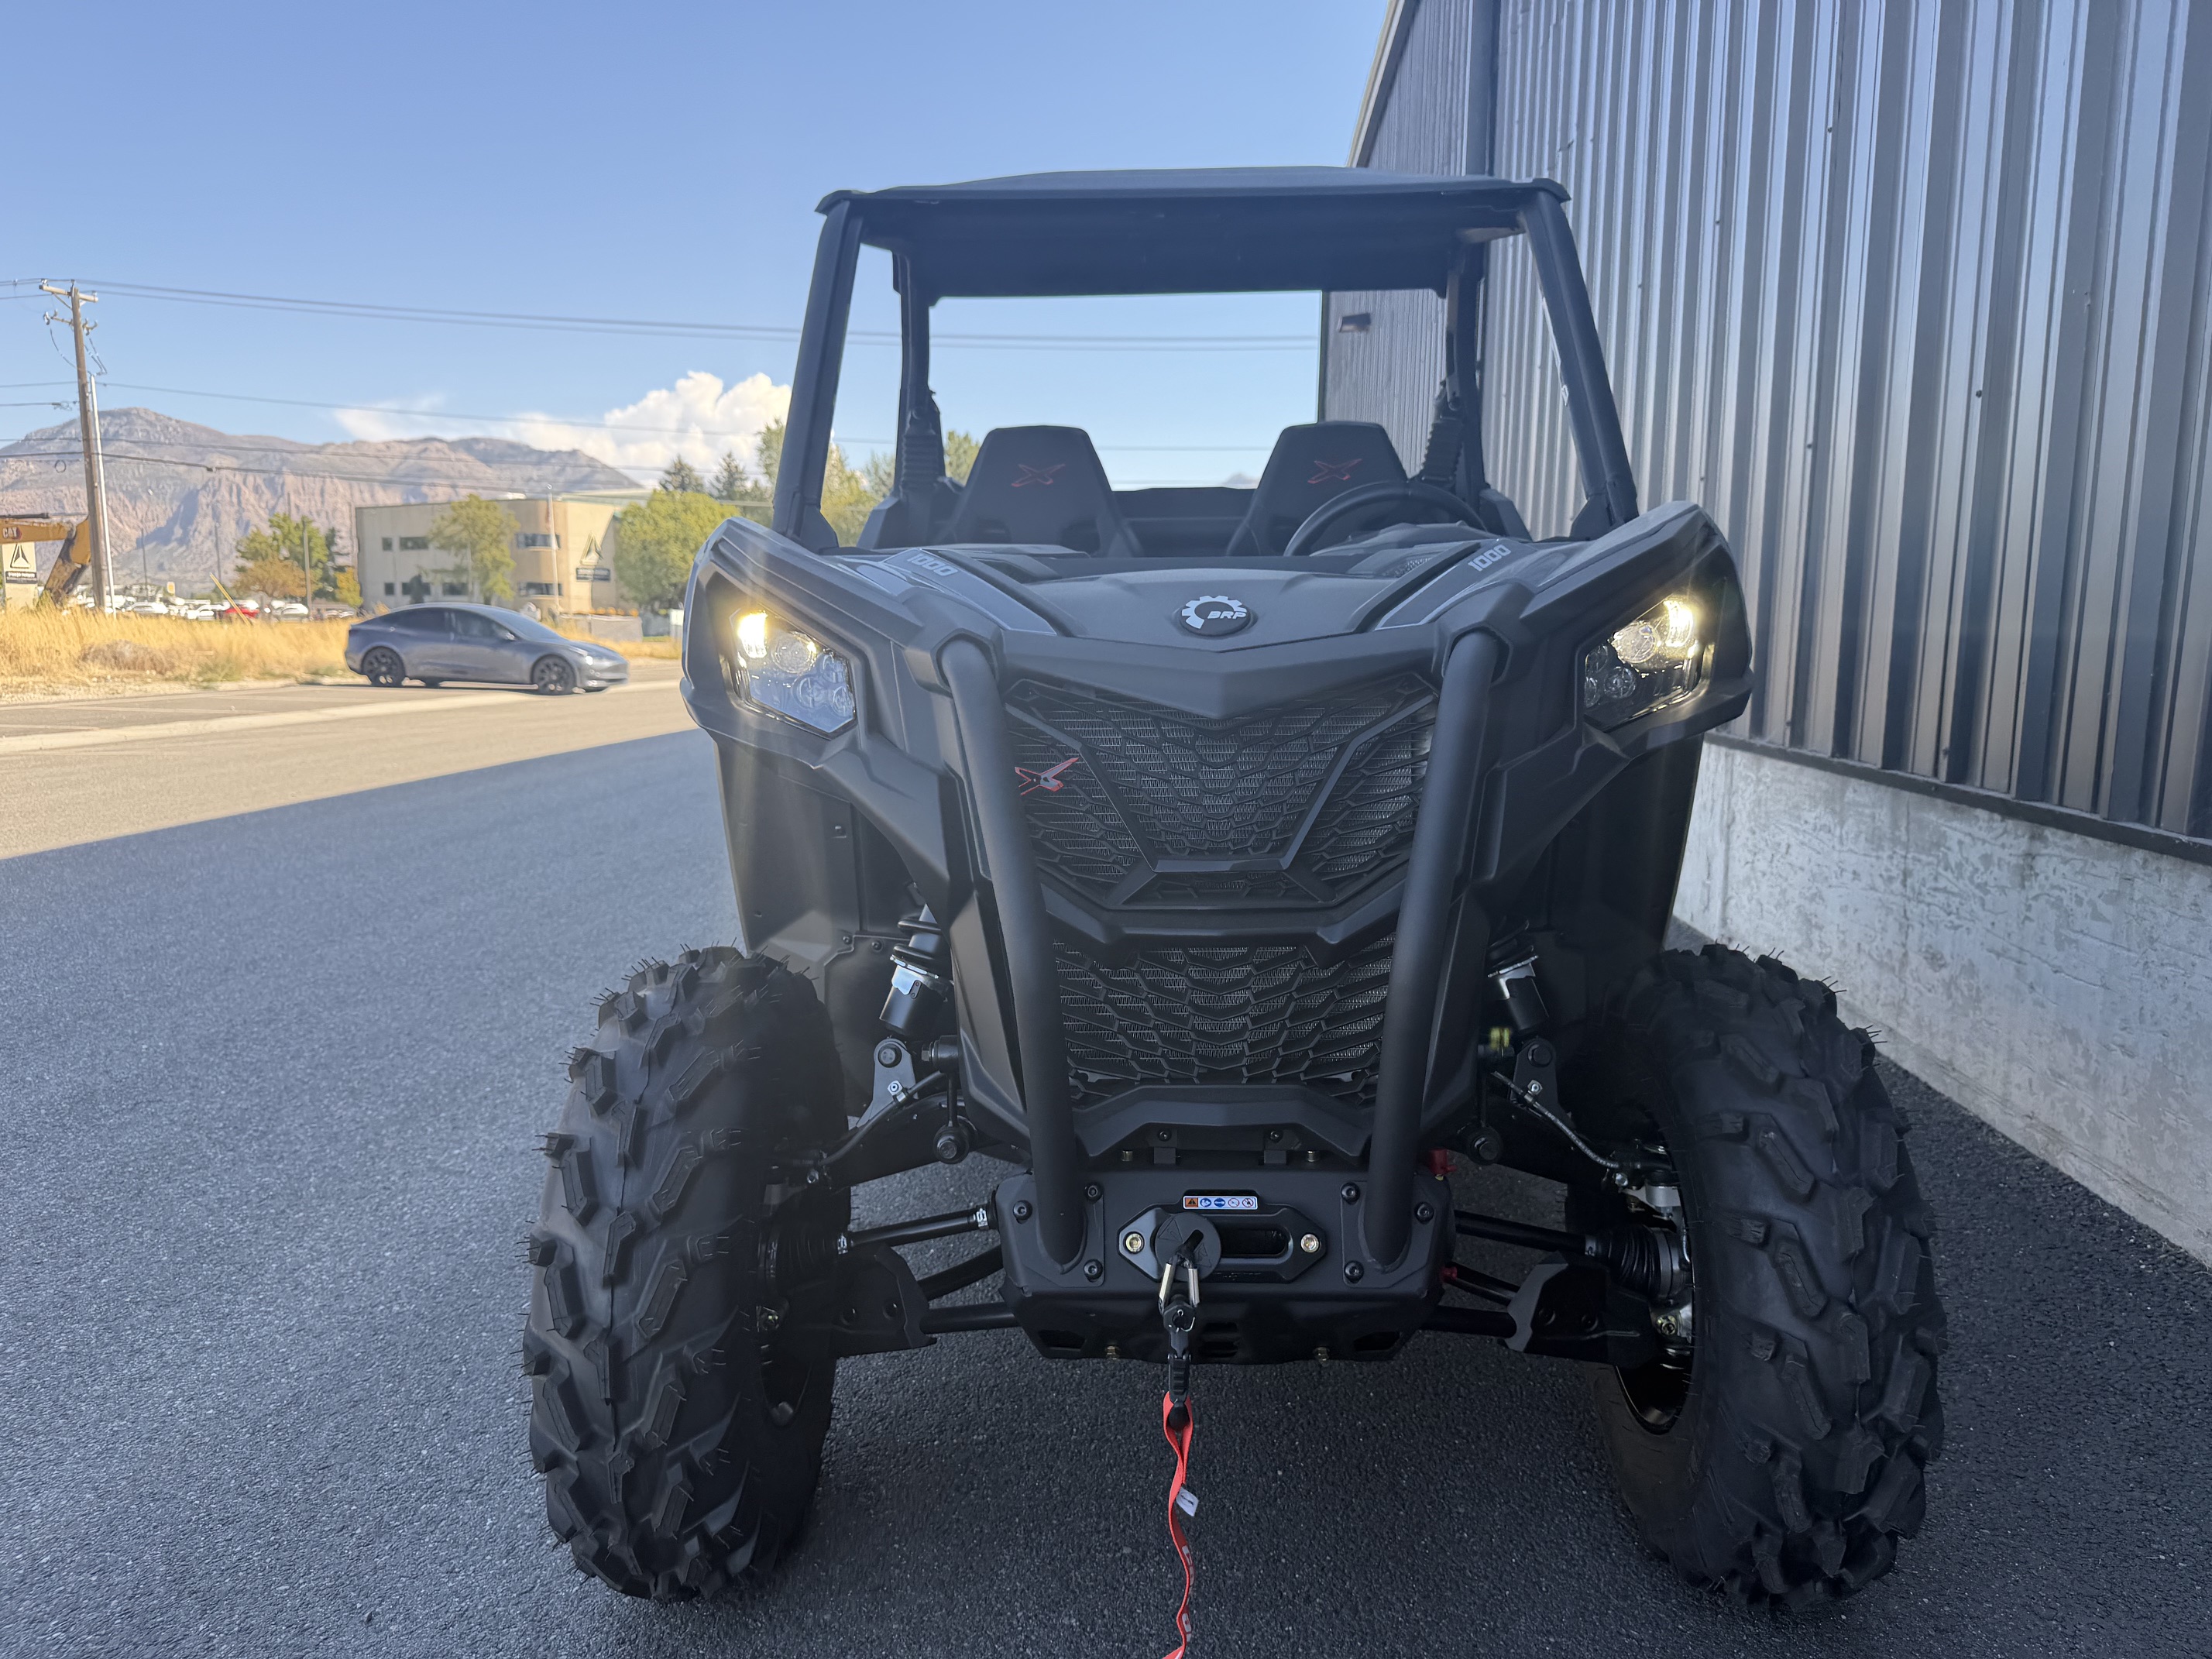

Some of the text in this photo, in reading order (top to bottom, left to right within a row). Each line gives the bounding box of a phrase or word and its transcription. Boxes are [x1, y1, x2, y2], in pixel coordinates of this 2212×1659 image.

[906, 553, 959, 576] 1000
[1468, 544, 1511, 572] 1000
[1207, 610, 1247, 620] BRP
